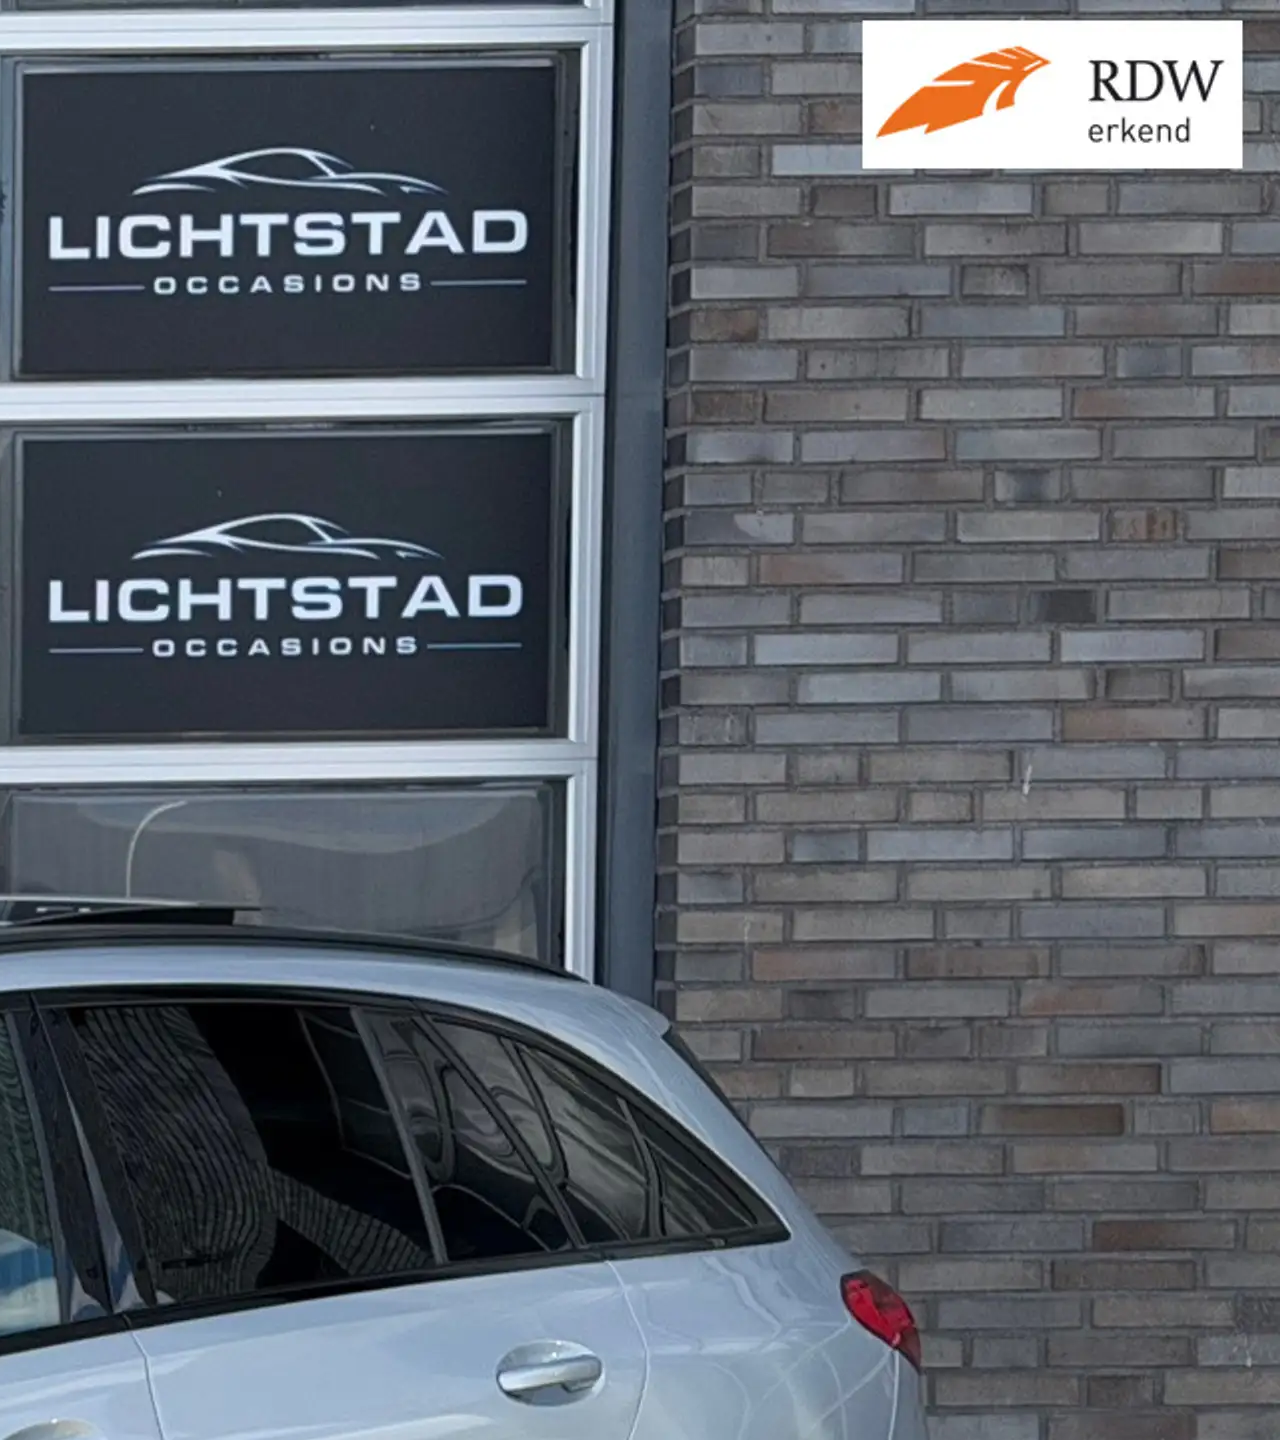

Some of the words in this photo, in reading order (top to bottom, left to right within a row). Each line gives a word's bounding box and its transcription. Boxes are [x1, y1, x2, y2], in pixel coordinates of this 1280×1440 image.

[49, 210, 528, 259] LICHTSTAD
[153, 273, 422, 295] OCCASIONS
[49, 575, 523, 622] LICHTSTAD
[152, 636, 418, 657] OCCASIONS
